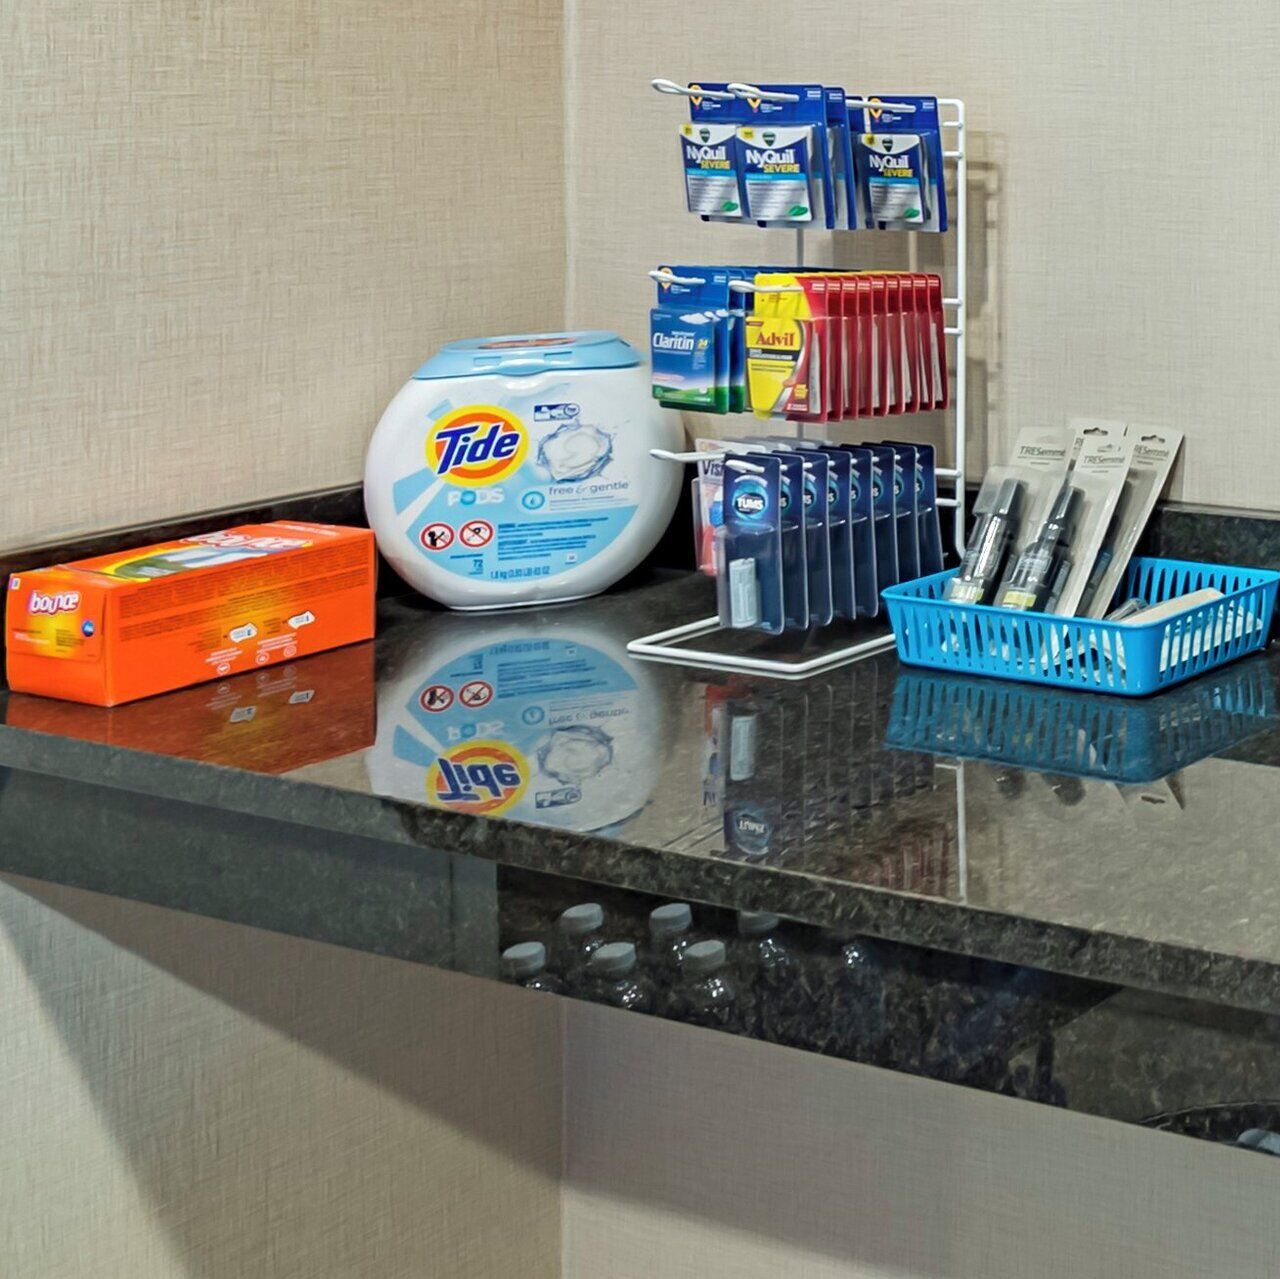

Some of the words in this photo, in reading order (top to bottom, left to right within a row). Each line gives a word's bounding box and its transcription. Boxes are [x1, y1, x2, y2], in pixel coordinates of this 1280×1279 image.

[686, 145, 726, 165] NyQuil
[745, 149, 796, 168] NyQuil
[869, 154, 910, 171] NyQuil
[701, 160, 730, 170] SEVERE
[763, 163, 799, 173] SEVERE
[881, 168, 913, 177] SEVERE
[653, 332, 695, 350] Claritin
[755, 331, 796, 347] Advil
[436, 424, 520, 475] Tide
[1134, 444, 1170, 458] RESemmé
[549, 486, 574, 496] free
[590, 481, 629, 495] gentle
[448, 488, 505, 506] PODS
[736, 495, 765, 511] TUMS
[29, 590, 80, 614] bounce
